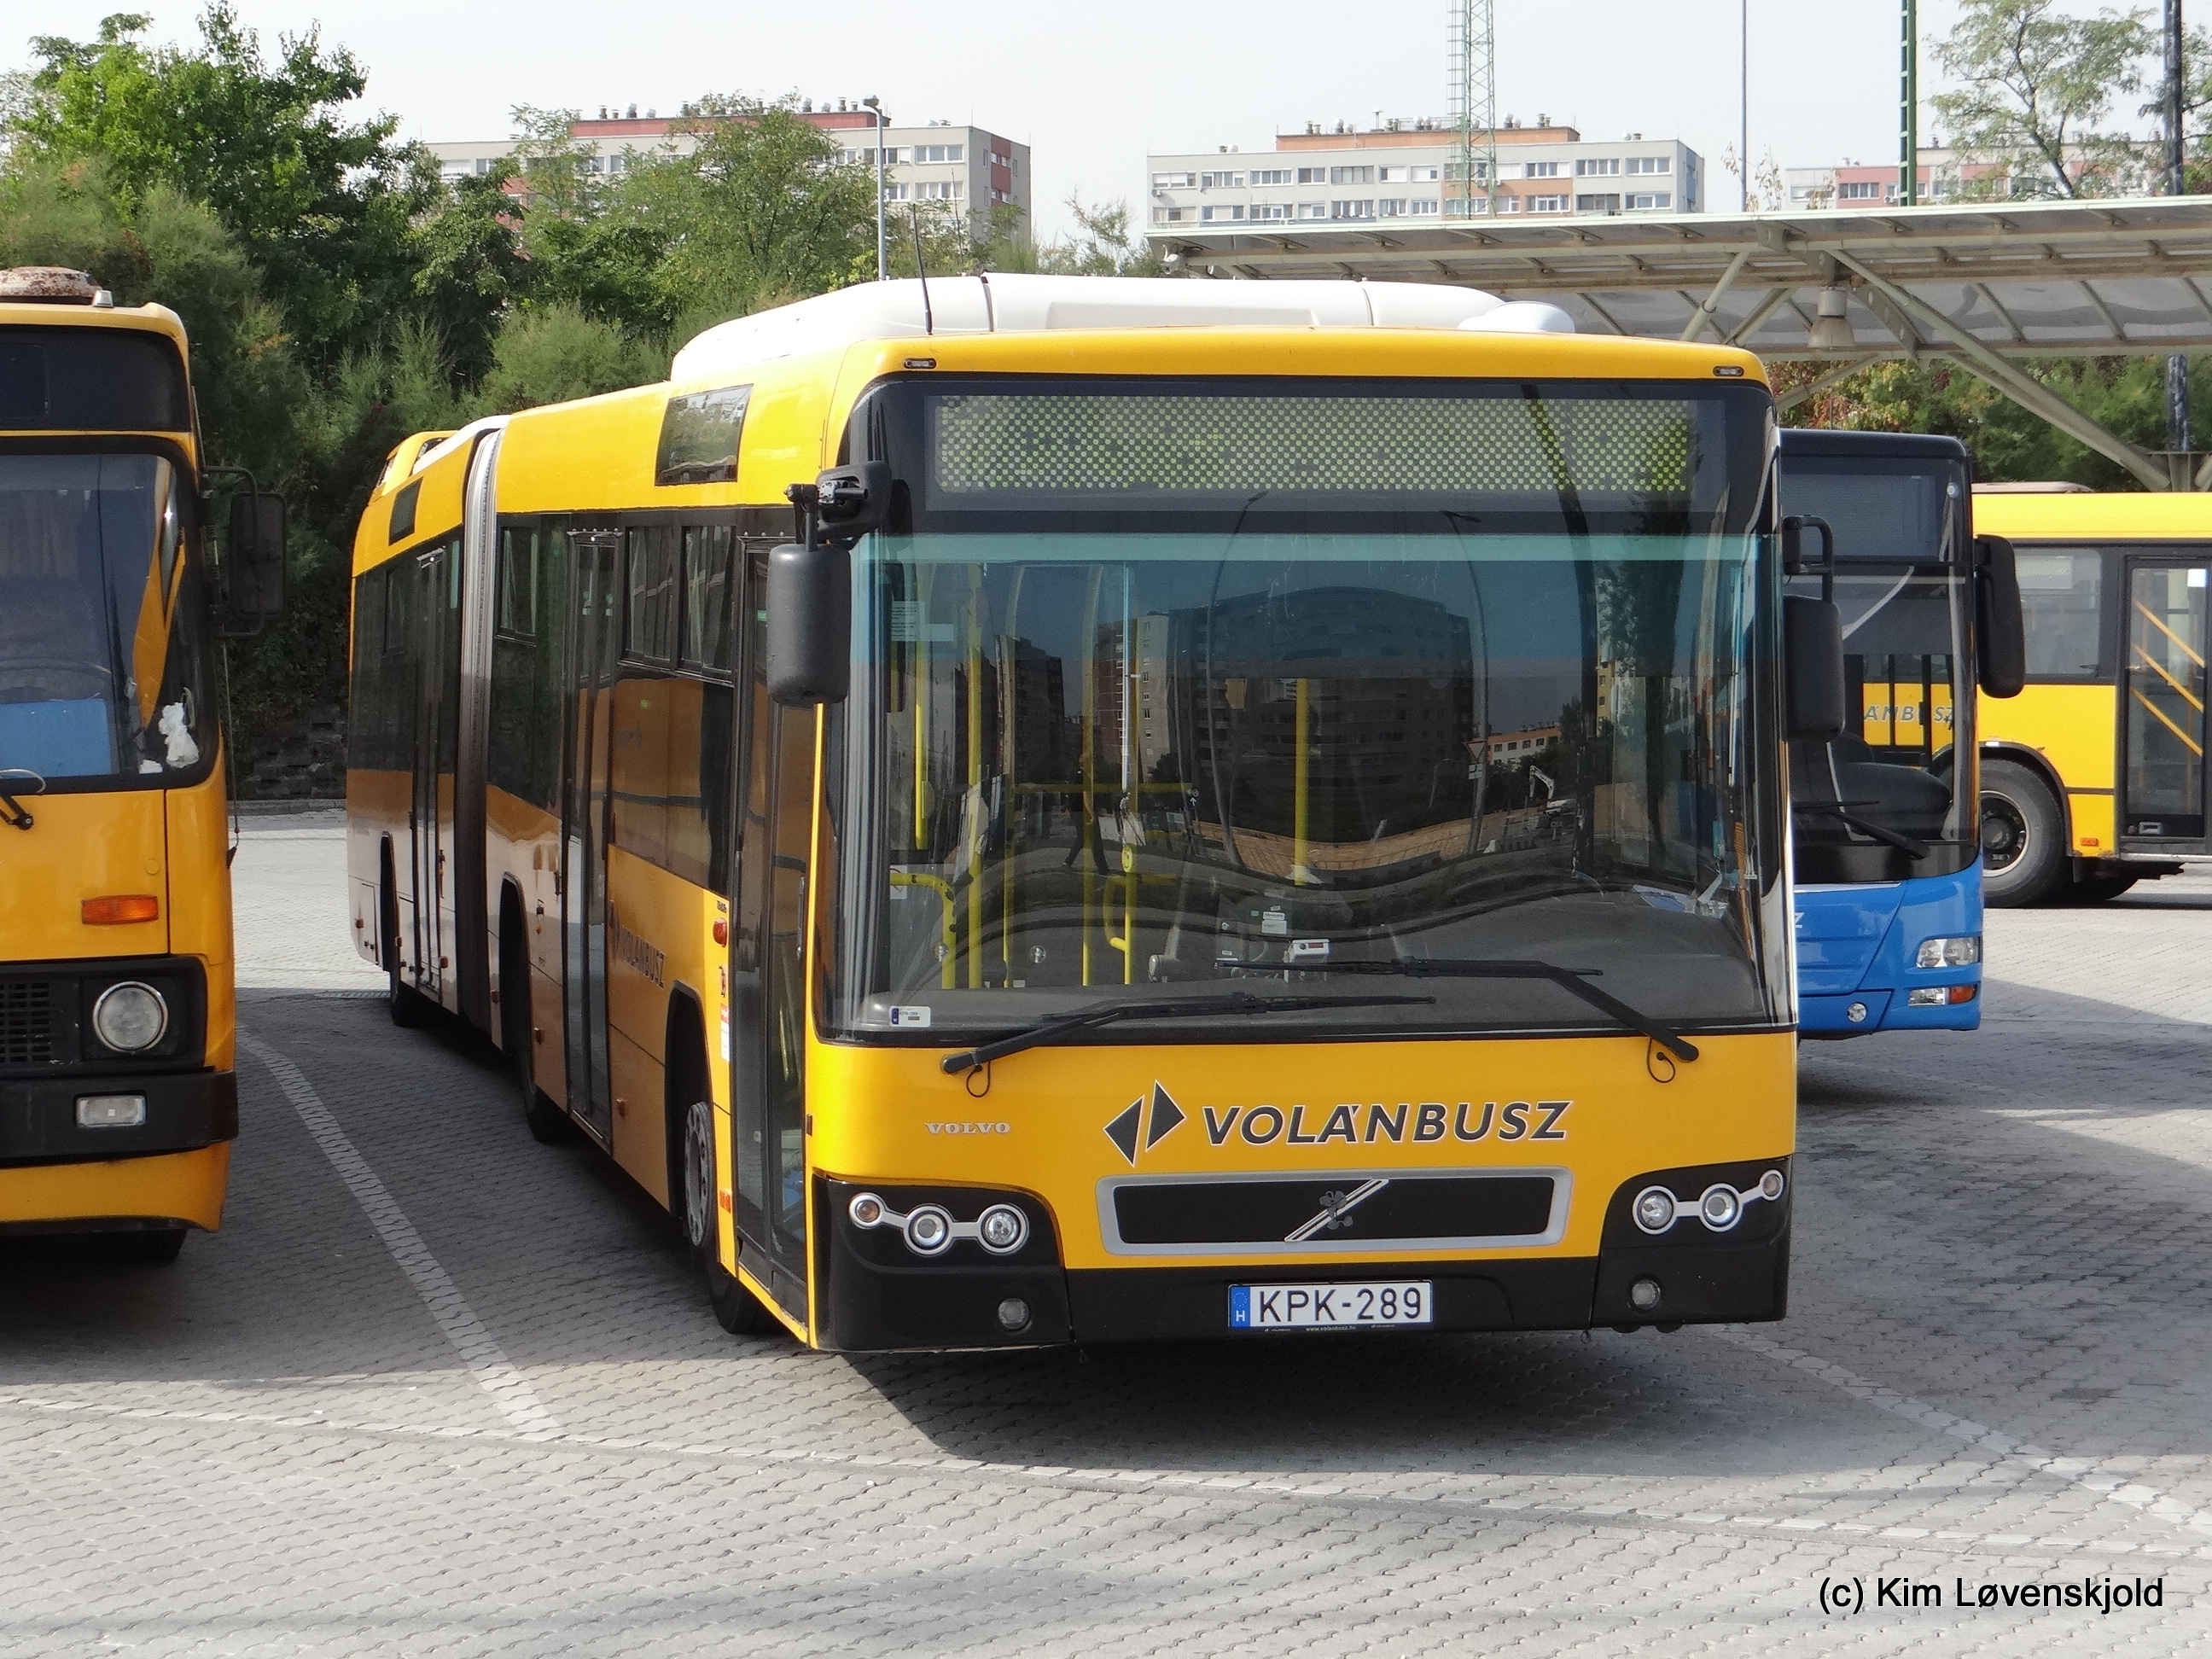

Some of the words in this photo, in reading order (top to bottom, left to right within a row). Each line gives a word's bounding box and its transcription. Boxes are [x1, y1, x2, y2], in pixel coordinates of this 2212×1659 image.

[924, 1122, 1011, 1134] VOLVO
[1202, 1100, 1574, 1146] VOLÁNBUSZ
[1236, 1310, 1245, 1322] H
[1259, 1286, 1422, 1323] KPK-289
